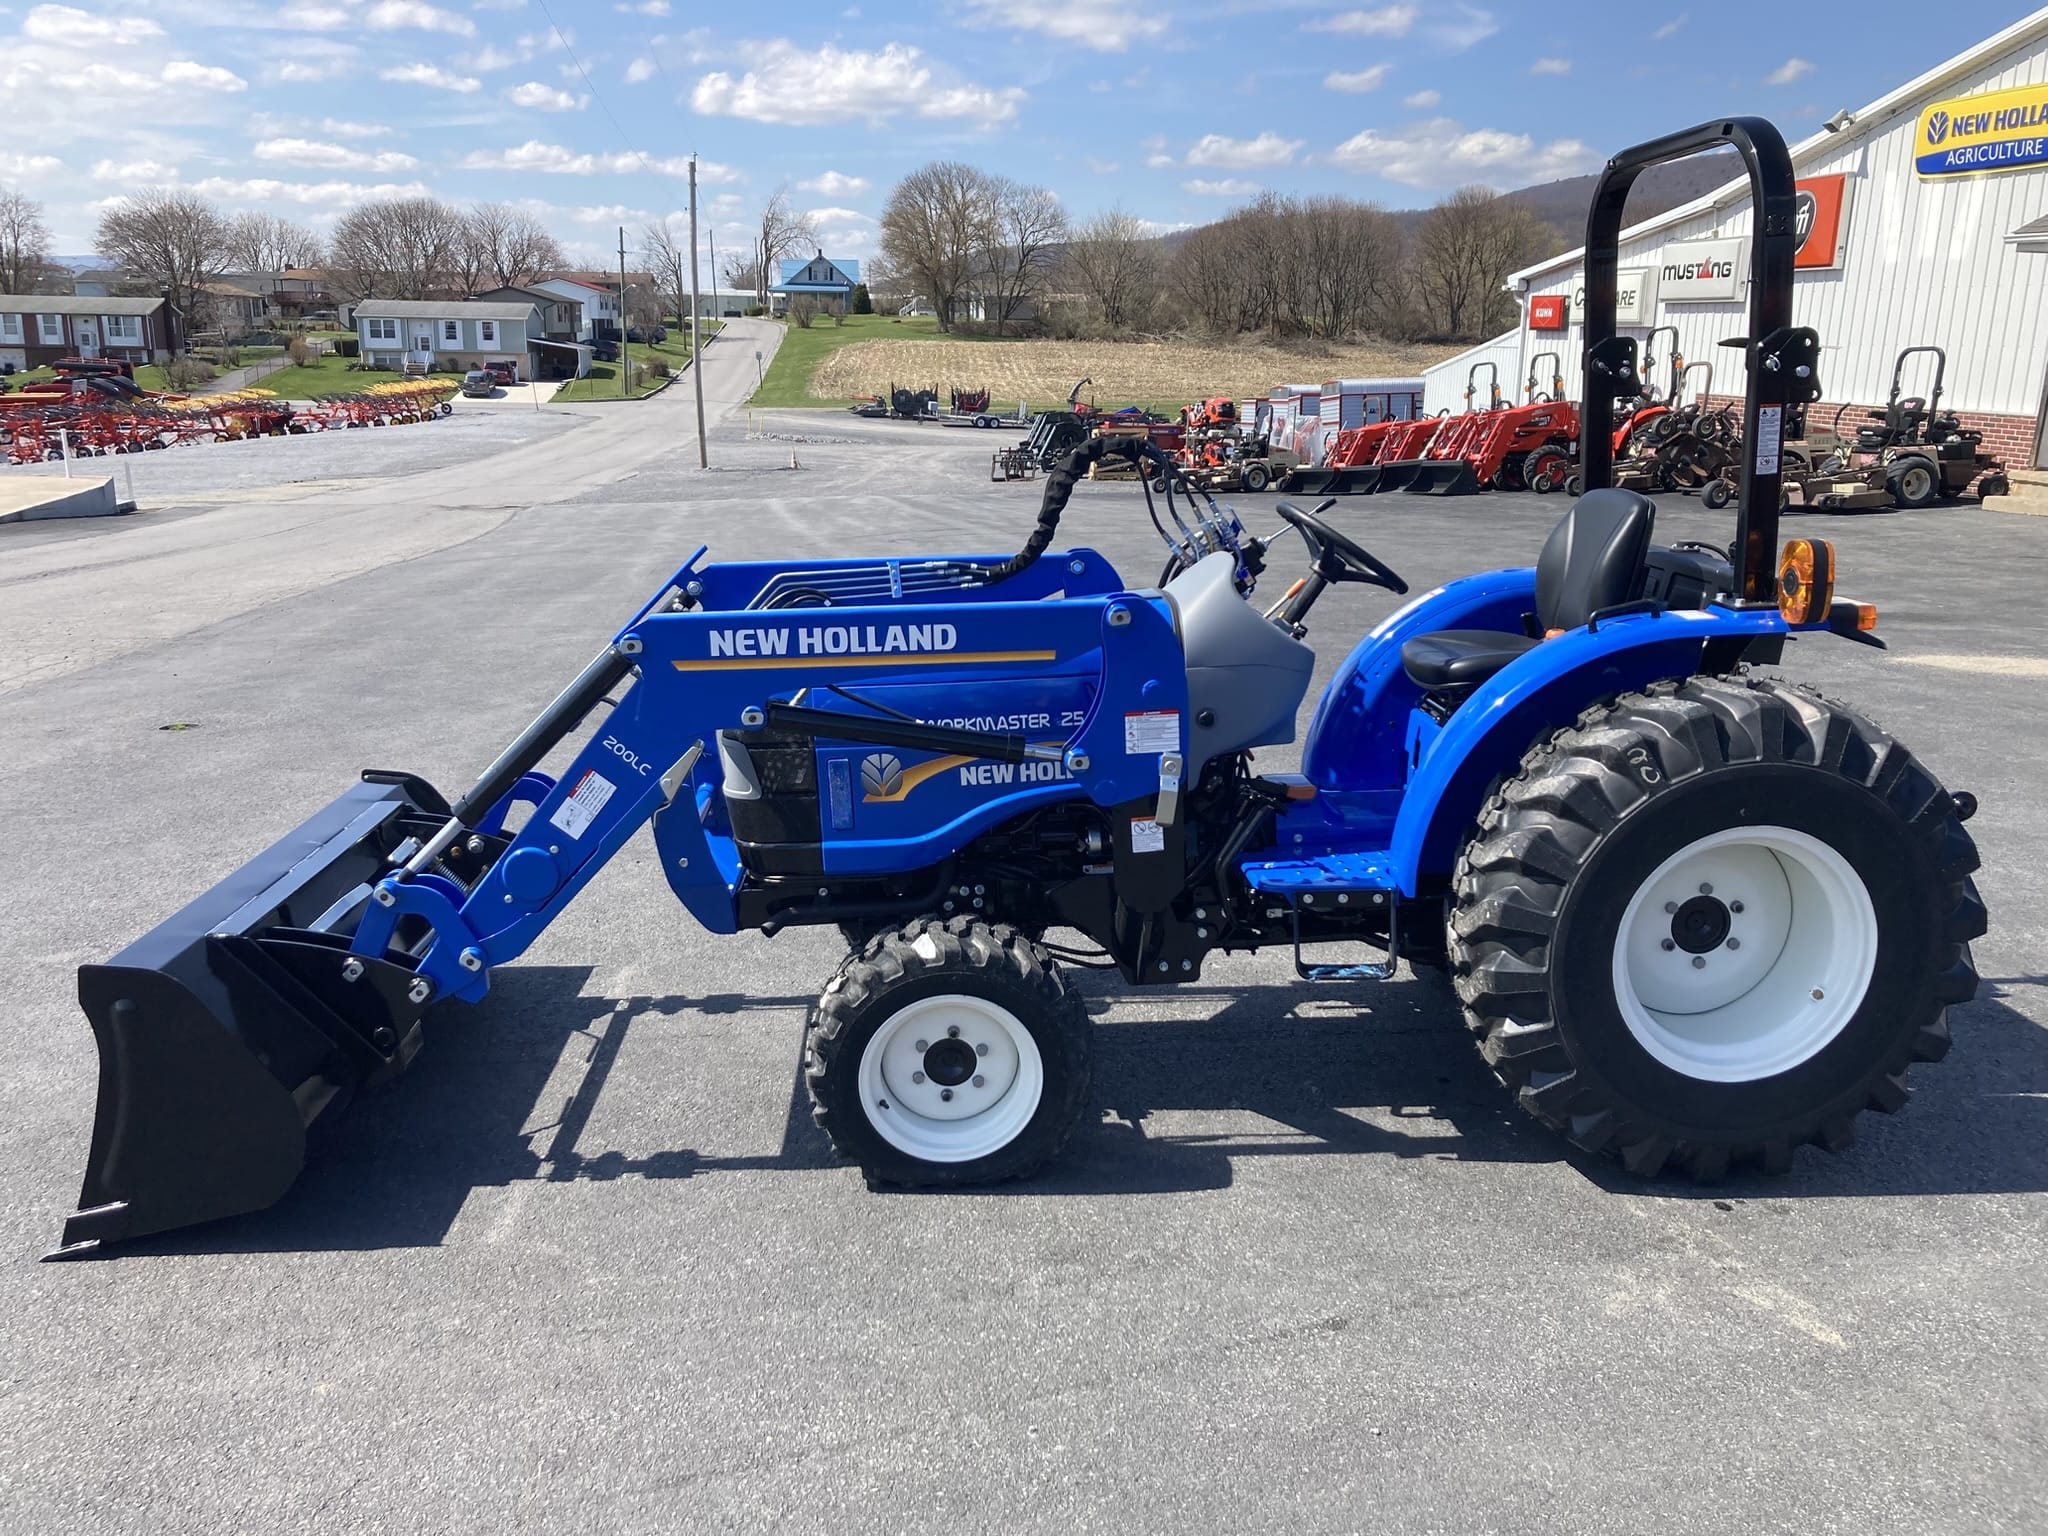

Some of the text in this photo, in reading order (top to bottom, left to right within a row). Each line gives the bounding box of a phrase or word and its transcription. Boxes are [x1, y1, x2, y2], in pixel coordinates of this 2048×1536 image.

[1951, 111, 1993, 138] NEW
[1945, 138, 2044, 166] AGRICULTURE
[1662, 258, 1733, 281] MUSTANG
[709, 623, 958, 657] NEW HOLLAND
[928, 710, 1086, 731] ORKMASTER 25
[602, 735, 653, 776] 200LC
[960, 763, 1014, 786] NEW
